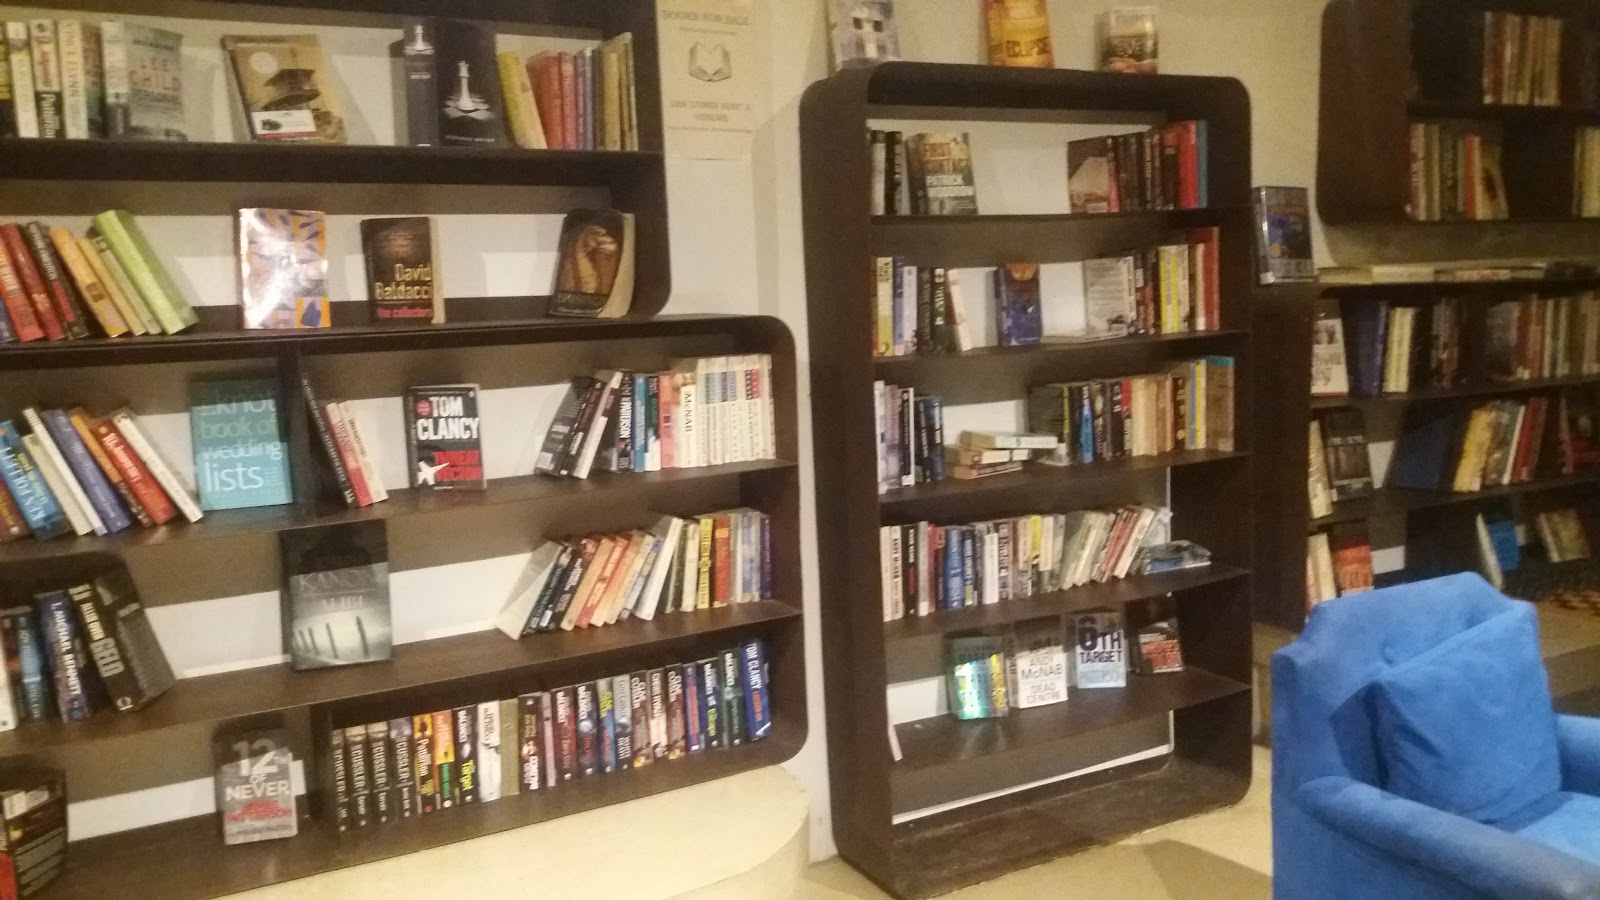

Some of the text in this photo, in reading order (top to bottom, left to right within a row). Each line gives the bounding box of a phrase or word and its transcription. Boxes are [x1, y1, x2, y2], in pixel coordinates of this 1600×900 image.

[394, 263, 432, 281] David
[375, 282, 432, 300] Baldacci
[430, 396, 464, 417] TOM
[416, 416, 481, 441] CLANCY
[204, 437, 281, 461] wedding
[206, 463, 264, 493] lists
[52, 609, 73, 652] MICHAEL
[1078, 616, 1122, 651] 6TH
[746, 643, 759, 659] TOM
[1029, 655, 1053, 667] ANDY
[1079, 651, 1122, 664] TARGET
[61, 653, 84, 696] BENNETT
[748, 660, 762, 689] CLANCY
[1022, 665, 1062, 681] McNAB
[1026, 690, 1061, 702] CENTRE
[1030, 682, 1057, 694] DEAD
[372, 746, 387, 785] CUSSLER
[396, 742, 410, 780] CUSSLER
[416, 739, 430, 776] Patterson
[249, 773, 266, 784] OF
[351, 751, 365, 789] CUSSLER
[459, 761, 475, 791] Target
[225, 780, 290, 802] NEVER
